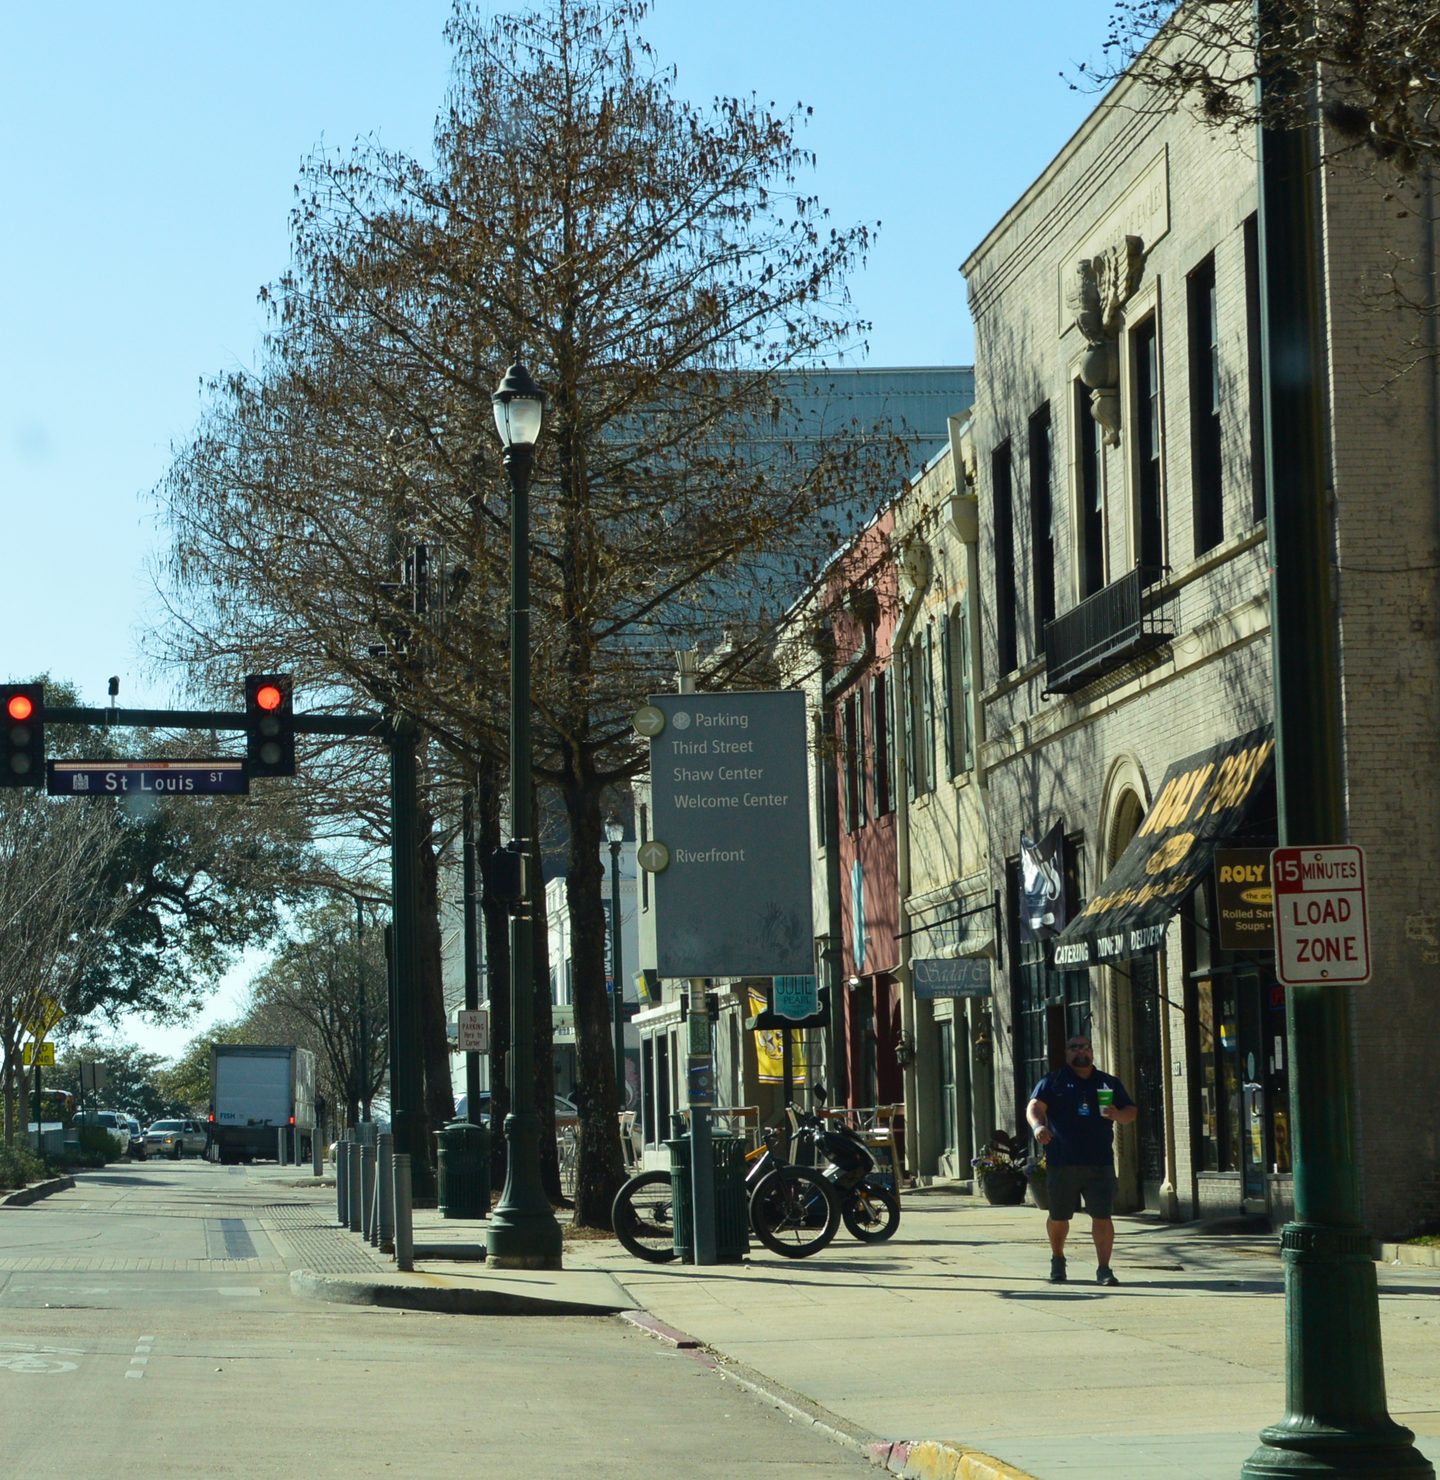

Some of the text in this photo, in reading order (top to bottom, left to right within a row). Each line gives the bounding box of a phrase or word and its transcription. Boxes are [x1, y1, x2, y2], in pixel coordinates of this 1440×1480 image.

[695, 713, 749, 728] Parking
[672, 739, 754, 755] Third Street
[105, 772, 223, 791] St Louis ST
[673, 766, 764, 782] Shaw Center
[674, 792, 788, 809] Welcome Center
[1138, 762, 1215, 838] ROLY
[675, 848, 745, 863] Riverfront
[1219, 865, 1265, 883] ROLY
[1276, 861, 1357, 882] 15 MINUTES
[1222, 909, 1253, 919] Rolled
[1293, 898, 1351, 926] LOAD
[1235, 921, 1265, 933] Soups
[1054, 941, 1089, 965] CATERING
[1130, 923, 1165, 951] DELIVERY
[1296, 936, 1358, 962] ZONE
[777, 976, 812, 995] JULIE
